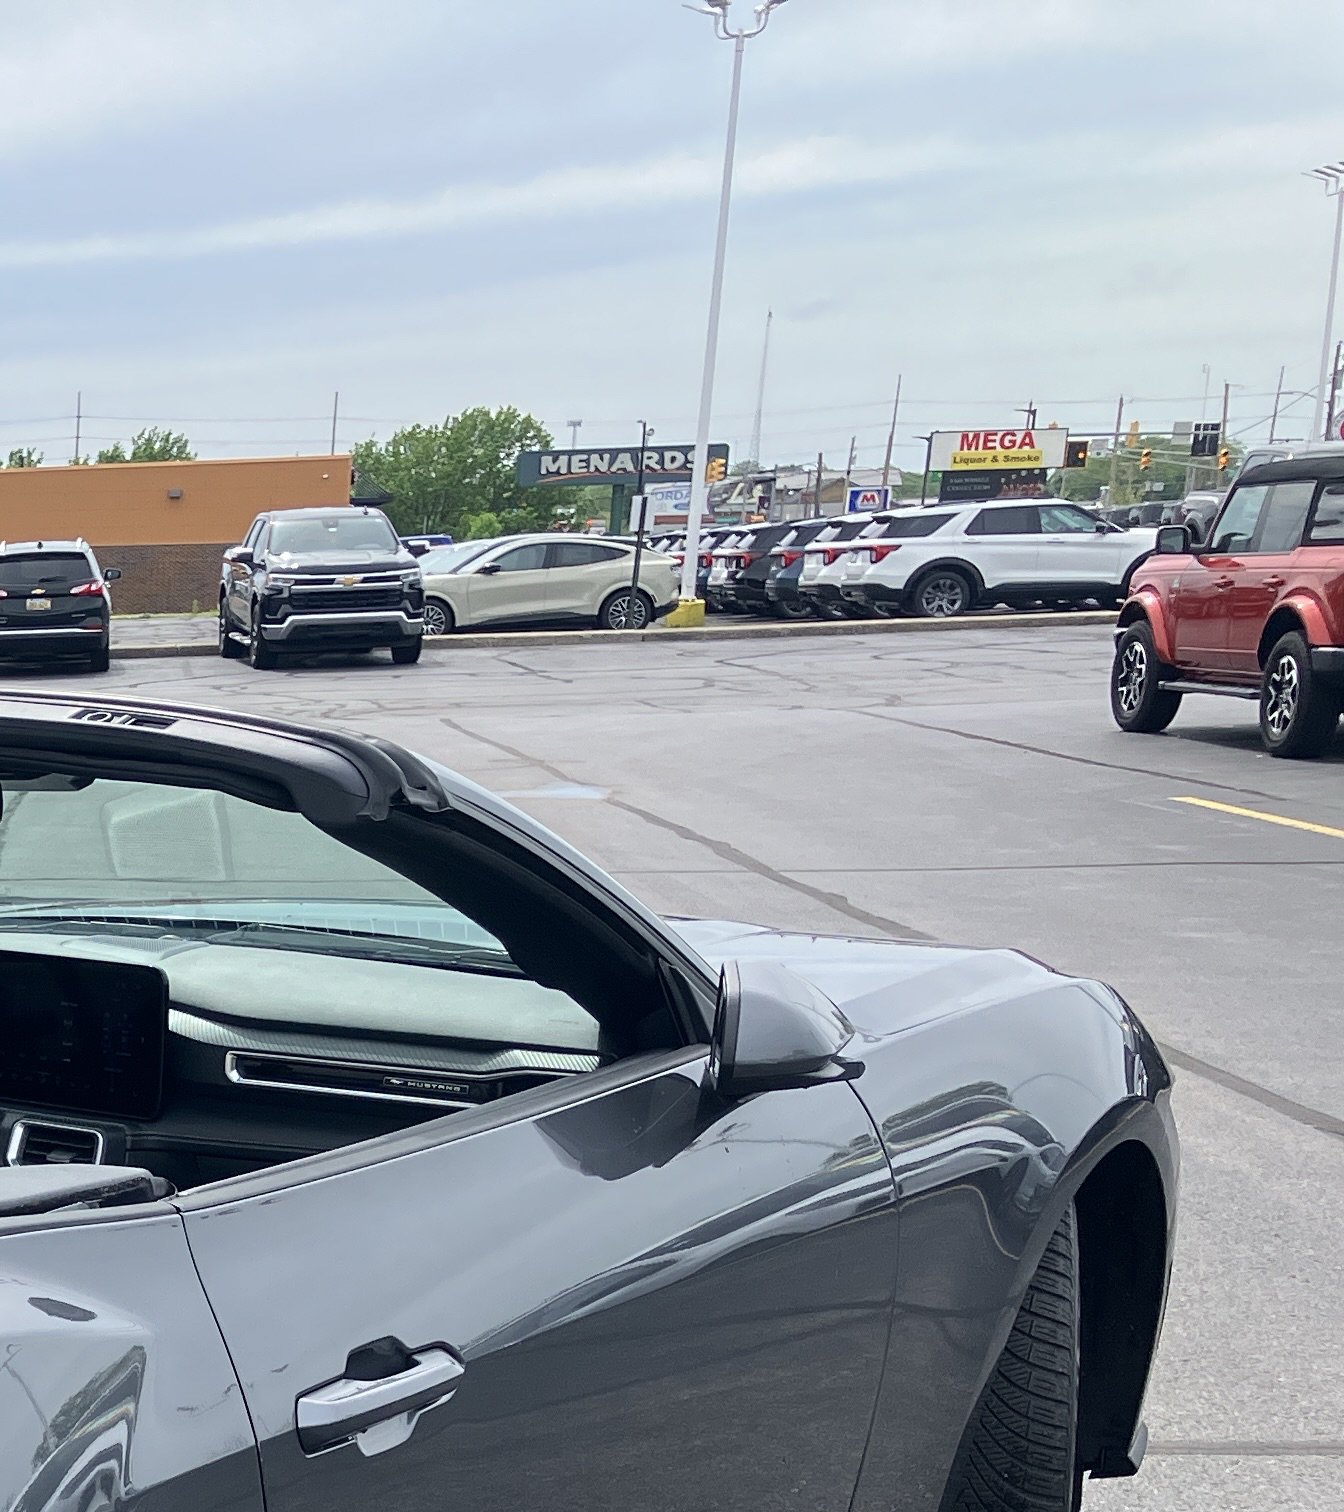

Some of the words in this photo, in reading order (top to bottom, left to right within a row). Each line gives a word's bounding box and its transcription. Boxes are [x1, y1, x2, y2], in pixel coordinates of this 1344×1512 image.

[960, 431, 1036, 451] MEGA
[953, 456, 987, 466] Liquor
[990, 455, 999, 463] &
[1002, 454, 1040, 462] Smoke
[408, 1081, 461, 1092] MUSTANG
